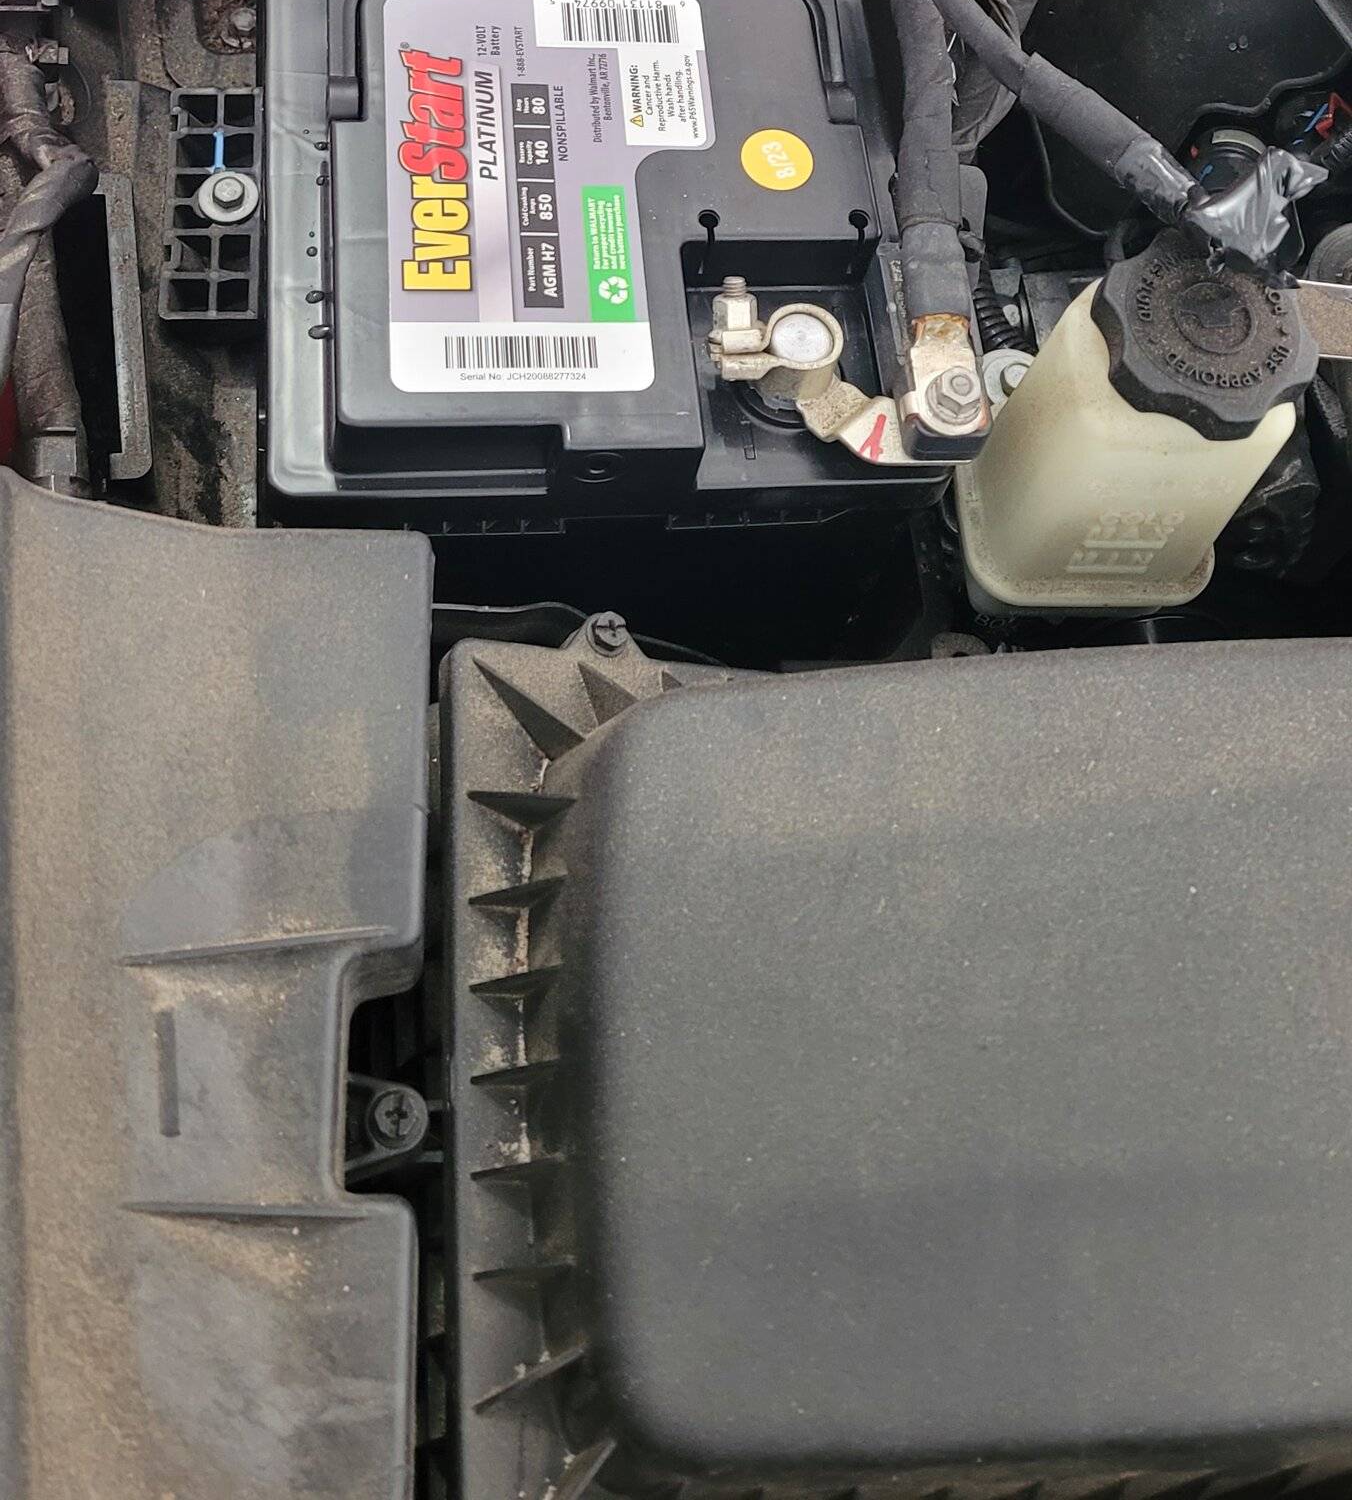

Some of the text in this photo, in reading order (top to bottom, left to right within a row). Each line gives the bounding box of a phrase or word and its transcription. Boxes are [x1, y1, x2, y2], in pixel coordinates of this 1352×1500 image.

[574, 0, 615, 8] 09974
[622, 0, 662, 9] 81131
[475, 25, 487, 57] 12-VOLT
[490, 26, 502, 56] Battery
[514, 26, 526, 78] 1-888-EVSTART
[598, 53, 608, 70] 72716
[600, 71, 608, 81] AR
[588, 68, 598, 95] Walmart
[629, 64, 642, 113] WARNING:
[642, 75, 654, 116] Cancer and
[652, 60, 666, 132] Reproductive Harm.
[664, 74, 675, 117] Wash hands
[675, 69, 687, 123] after handling.
[684, 54, 699, 139] www.P65Warnings.ca.gov
[515, 98, 523, 112] Amp
[531, 97, 546, 115] 80
[590, 96, 600, 104] by
[474, 70, 498, 181] PLATINUM
[553, 85, 568, 162] NONSPILLABLE
[592, 106, 602, 143] Distributed
[525, 140, 534, 165] Capacity
[535, 140, 549, 165] 140
[397, 48, 472, 292] EverStart
[520, 187, 530, 226] Cold Cranking
[529, 198, 537, 214] Amps
[538, 194, 553, 221] 850
[526, 247, 537, 292] Part Number
[541, 242, 558, 298] AGM H7
[460, 372, 486, 381] Serial
[1166, 345, 1292, 388] USE APPROVED
